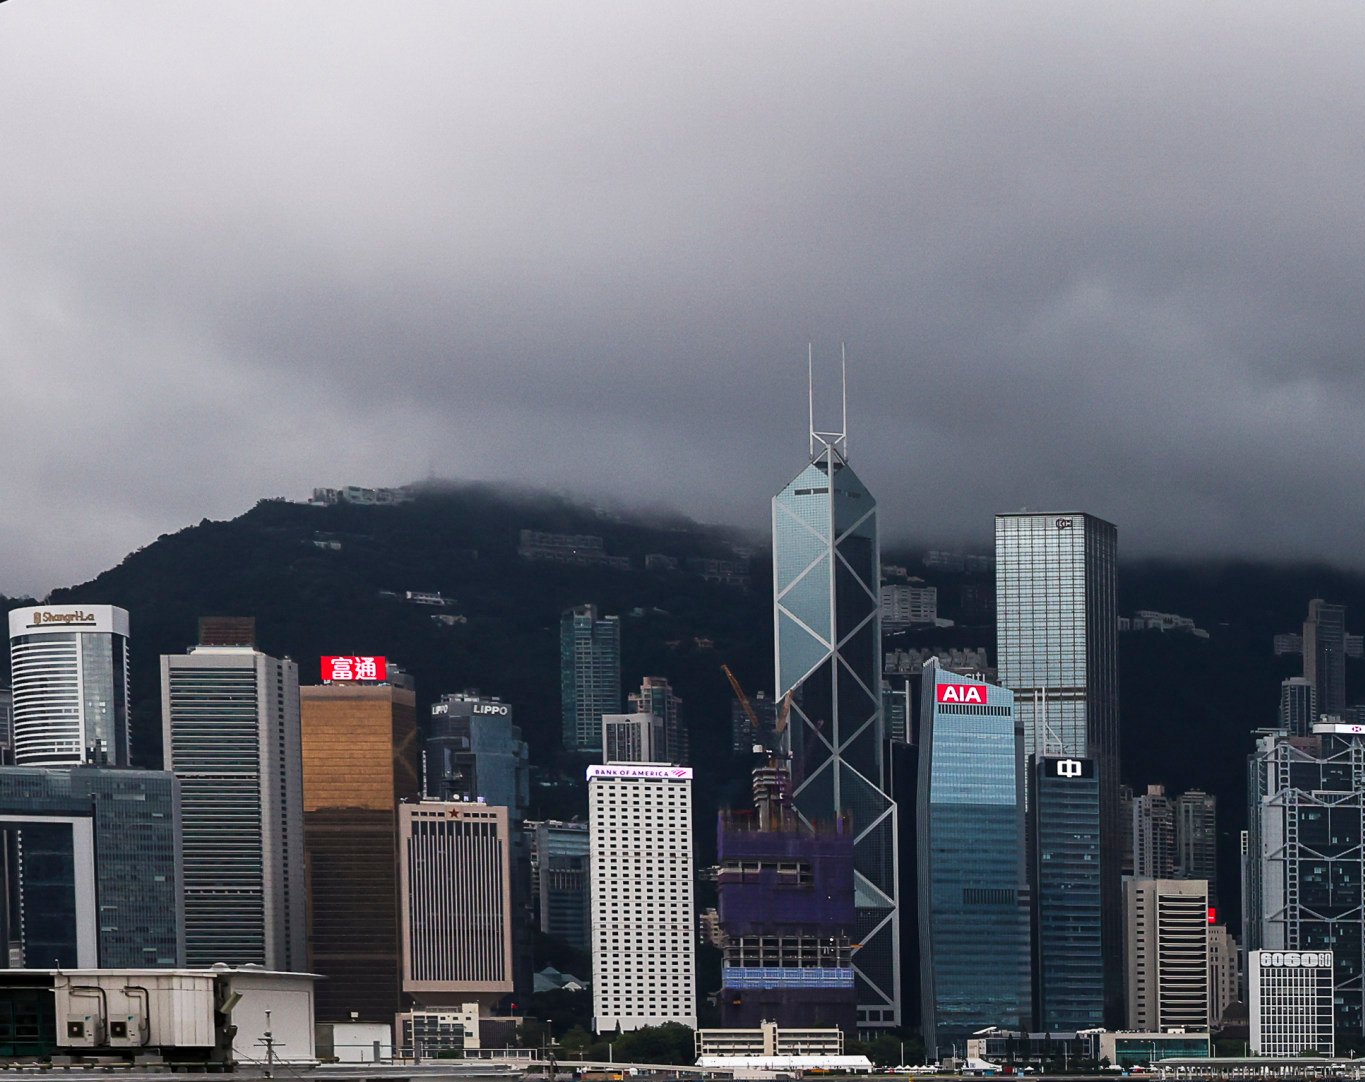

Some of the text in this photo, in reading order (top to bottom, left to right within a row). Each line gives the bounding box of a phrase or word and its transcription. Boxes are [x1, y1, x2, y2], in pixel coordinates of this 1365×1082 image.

[43, 611, 95, 623] Shangri-La
[331, 657, 377, 680] 富通
[942, 686, 981, 702] AIA
[473, 704, 508, 715] LIPPO
